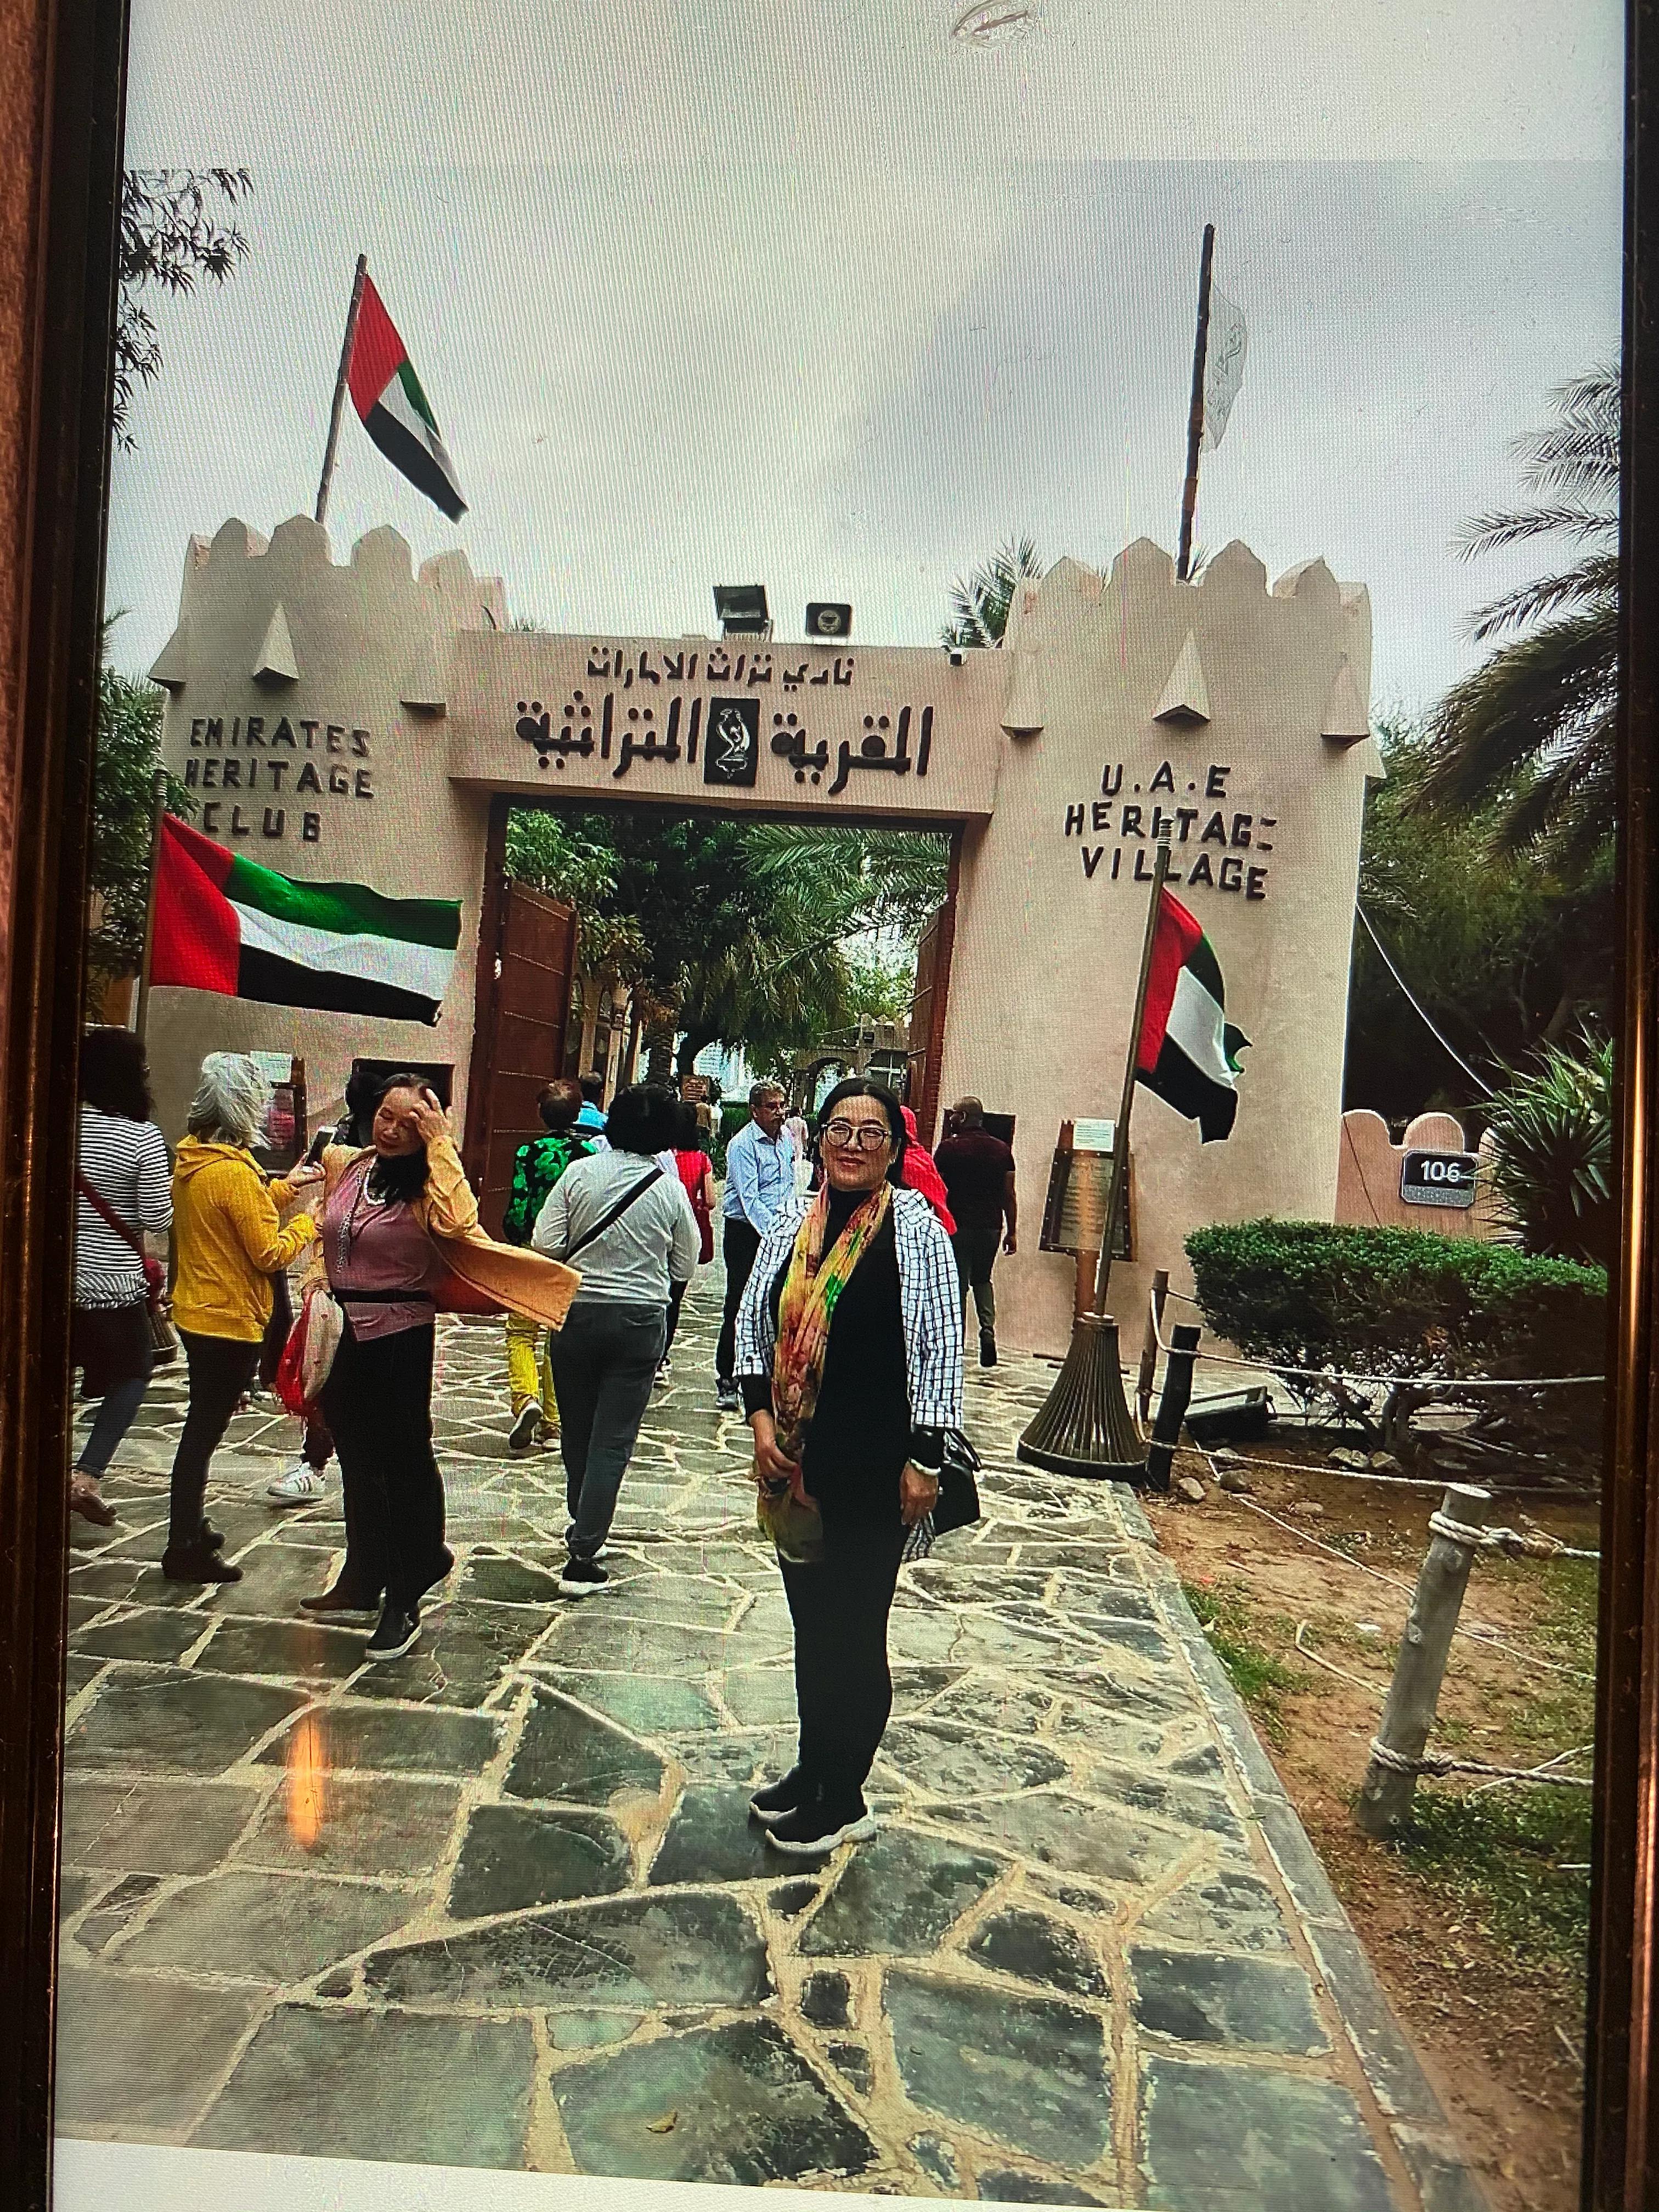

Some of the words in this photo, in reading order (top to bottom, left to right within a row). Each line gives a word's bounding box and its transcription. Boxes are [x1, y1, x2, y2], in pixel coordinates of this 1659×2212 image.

[190, 715, 371, 758] EMIRATES
[516, 690, 702, 778] التراثية
[771, 706, 935, 795] القرية
[185, 758, 375, 799] HERITAGE
[1100, 760, 1232, 798] U.A.E
[204, 802, 321, 842] CLUB
[1081, 845, 1268, 900] VILLAGE
[1421, 1160, 1460, 1183] 106
